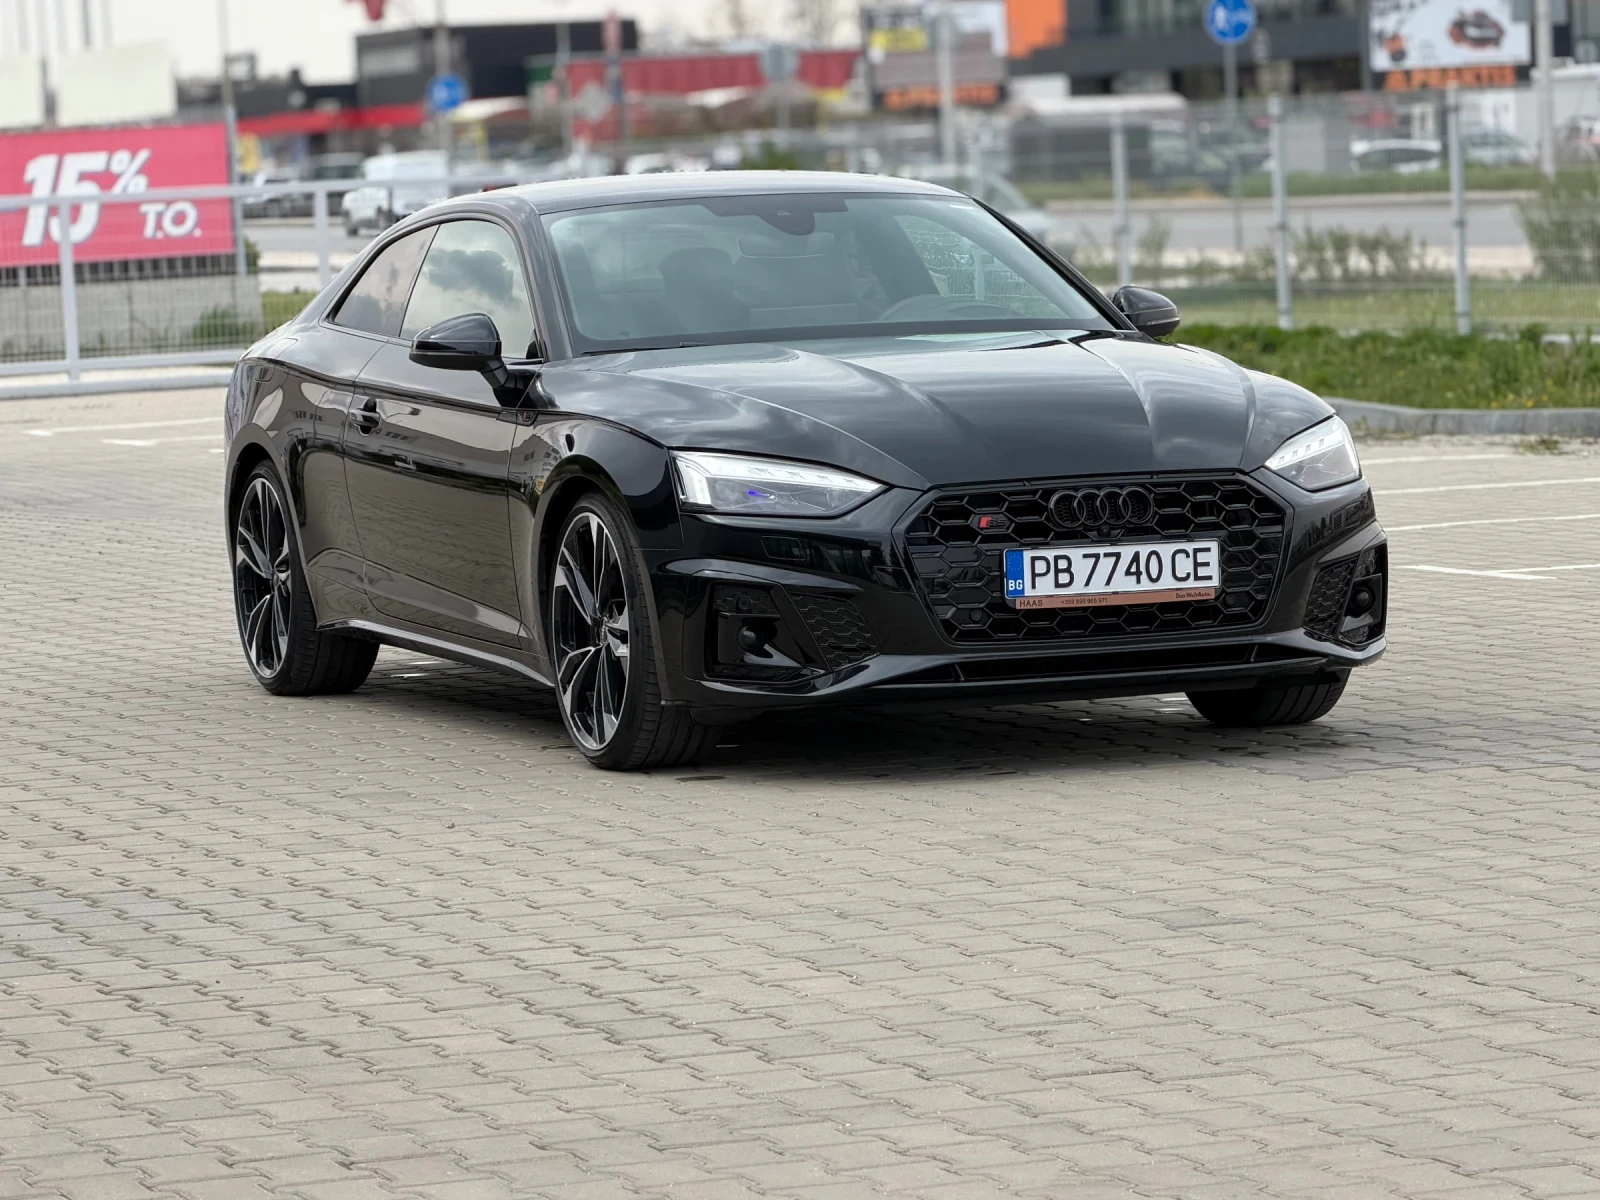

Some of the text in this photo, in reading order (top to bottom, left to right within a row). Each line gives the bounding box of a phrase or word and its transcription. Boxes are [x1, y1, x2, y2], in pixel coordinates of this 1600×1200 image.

[1030, 547, 1213, 589] PB 7740 CE
[1008, 579, 1023, 590] BG
[1019, 599, 1043, 607] HAAS
